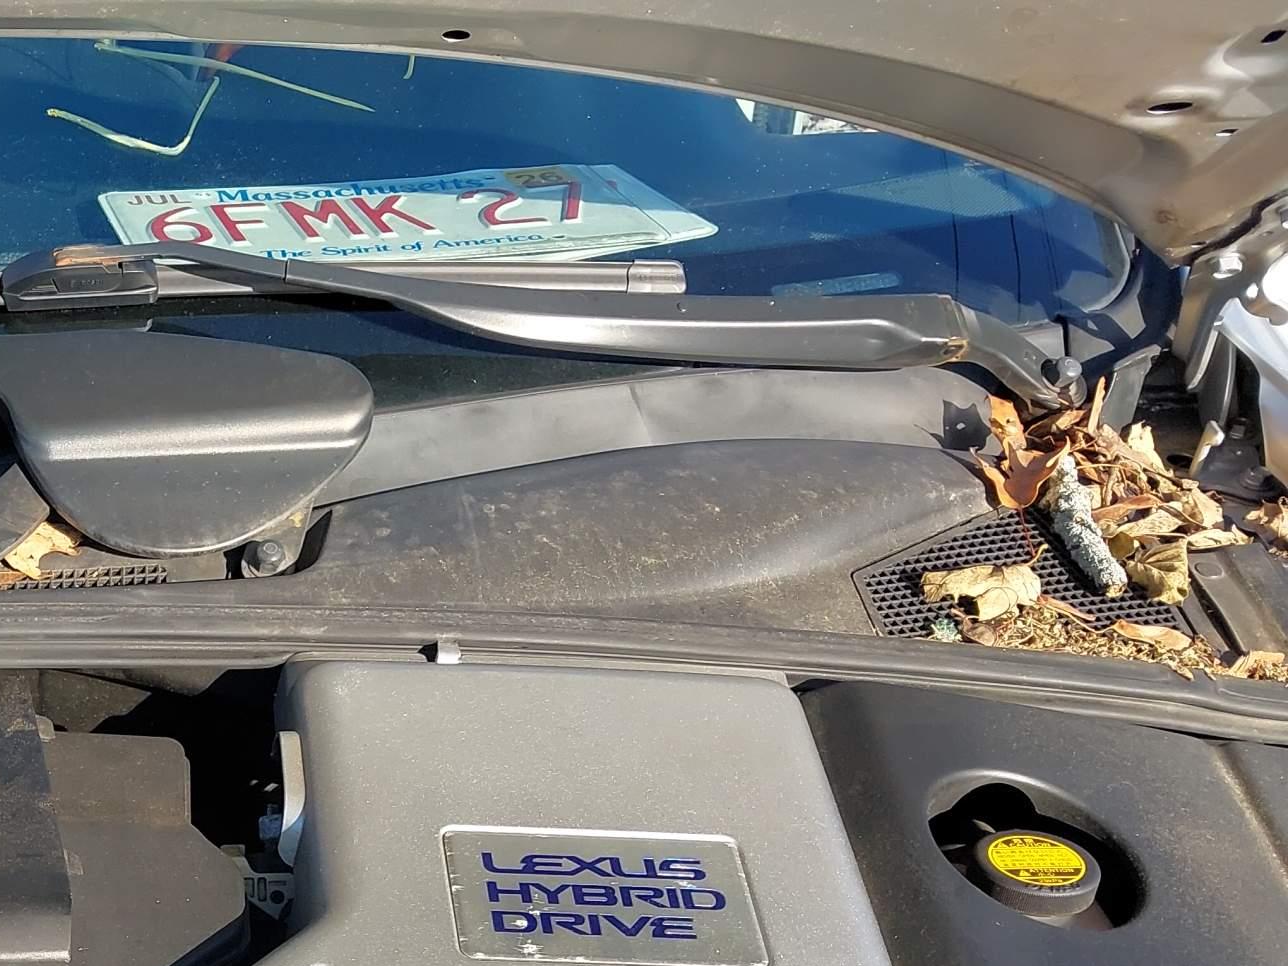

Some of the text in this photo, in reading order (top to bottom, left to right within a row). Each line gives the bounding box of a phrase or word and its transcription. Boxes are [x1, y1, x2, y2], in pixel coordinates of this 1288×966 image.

[215, 176, 484, 203] Massachusetts
[515, 170, 560, 184] 26
[128, 193, 192, 206] JUL
[149, 181, 583, 244] 6FMK 27
[260, 233, 545, 260] The Spirit of America
[480, 851, 707, 881] LEXUS
[485, 880, 727, 911] HYBRID
[490, 909, 699, 940] DRIVE
